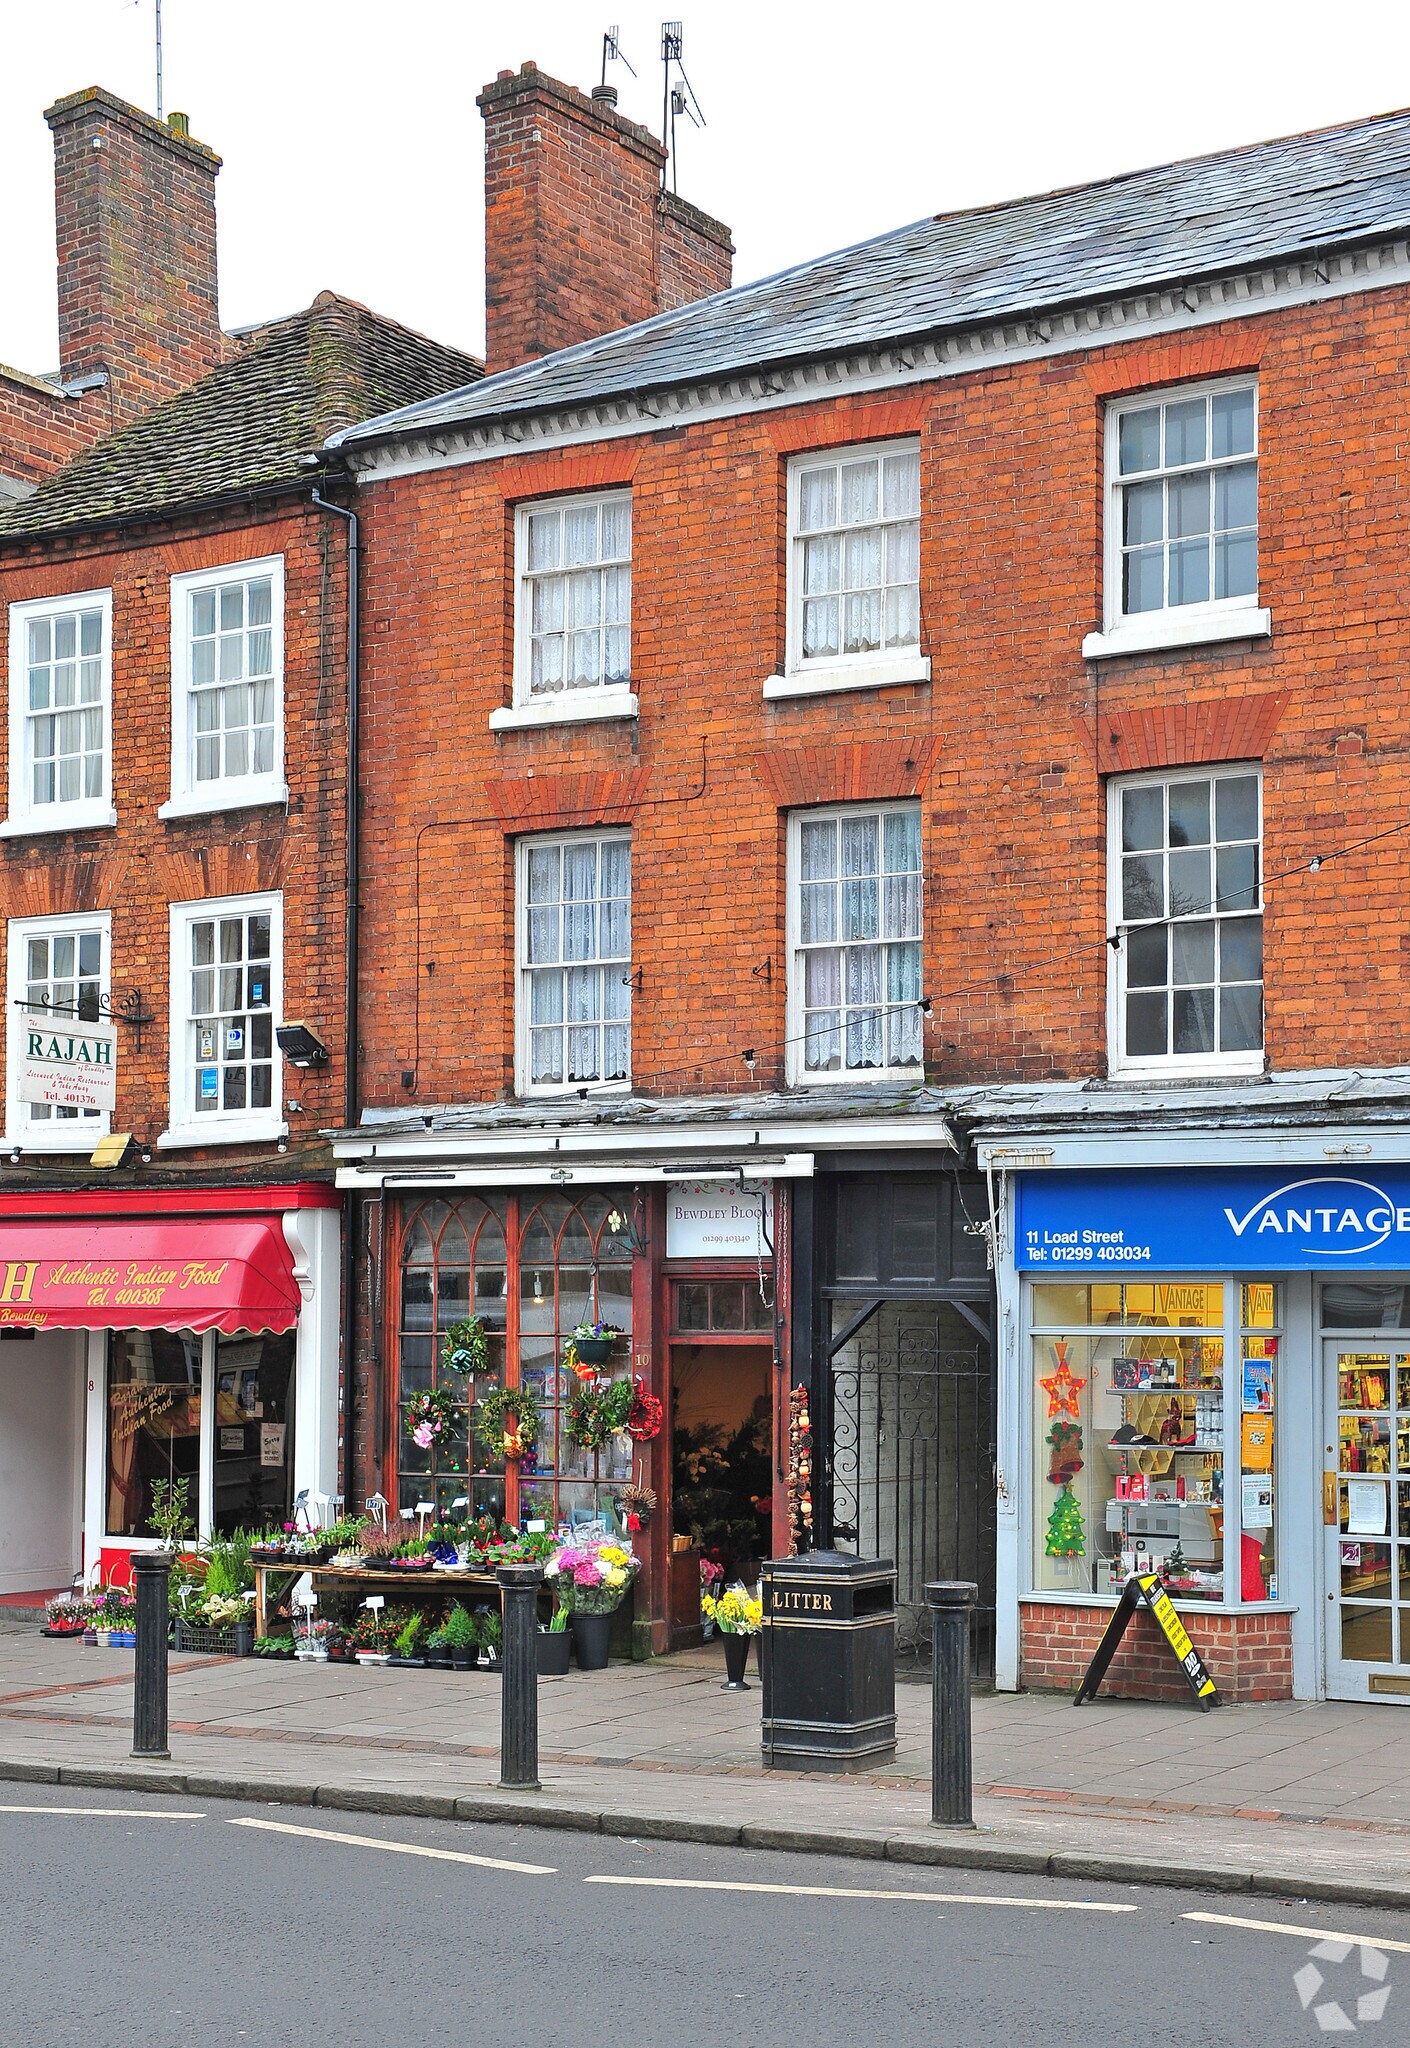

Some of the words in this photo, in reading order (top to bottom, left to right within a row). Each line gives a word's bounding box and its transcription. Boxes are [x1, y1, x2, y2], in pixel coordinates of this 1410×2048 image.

[27, 1033, 112, 1064] RAJAH
[78, 1075, 110, 1086] Restaurant
[44, 1091, 60, 1101] Tel.
[64, 1094, 96, 1104] 401376
[675, 1206, 727, 1219] BEWDLEY
[1224, 1208, 1410, 1236] VANTAGE
[702, 1235, 722, 1243] 01299
[725, 1235, 750, 1243] 403340
[1026, 1230, 1038, 1243] 11
[1044, 1230, 1078, 1243] Load
[1082, 1230, 1124, 1243] Street
[1026, 1247, 1047, 1260] Tel:
[1052, 1247, 1093, 1260] 01299
[1097, 1246, 1151, 1260] 403034
[43, 1263, 120, 1288] Authentic
[124, 1263, 178, 1286] Indian
[178, 1261, 223, 1289] Food
[87, 1288, 109, 1306] Tel.
[115, 1288, 166, 1305] 400368
[1159, 1284, 1204, 1313] VANTAGE
[0, 1308, 48, 1326] Bewdley
[636, 1354, 649, 1366] 10
[89, 1380, 94, 1391] 8
[120, 1384, 167, 1425] Authentic
[112, 1416, 147, 1443] Indian
[149, 1391, 174, 1420] Food
[773, 1592, 832, 1610] LITTER
